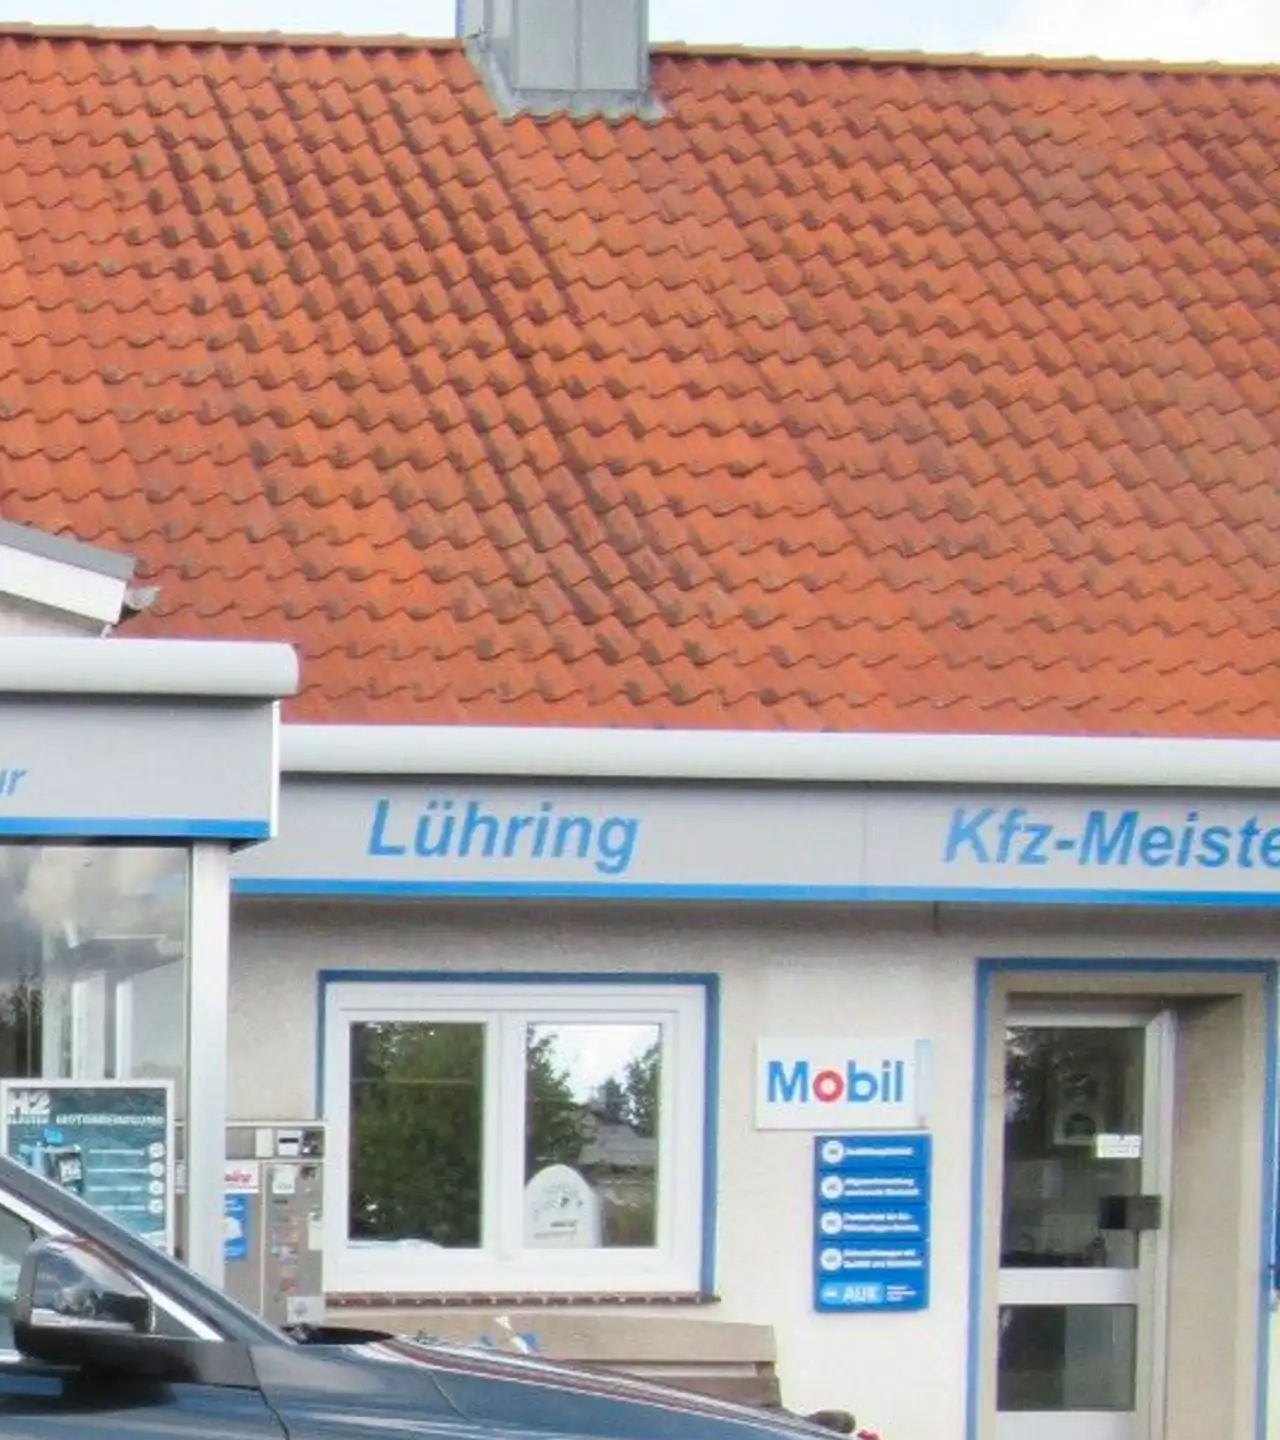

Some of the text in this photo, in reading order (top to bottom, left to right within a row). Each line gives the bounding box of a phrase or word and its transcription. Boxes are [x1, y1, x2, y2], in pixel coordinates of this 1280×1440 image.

[366, 798, 640, 874] Lühring
[7, 1090, 51, 1115] H2
[768, 1059, 905, 1103] Mobil
